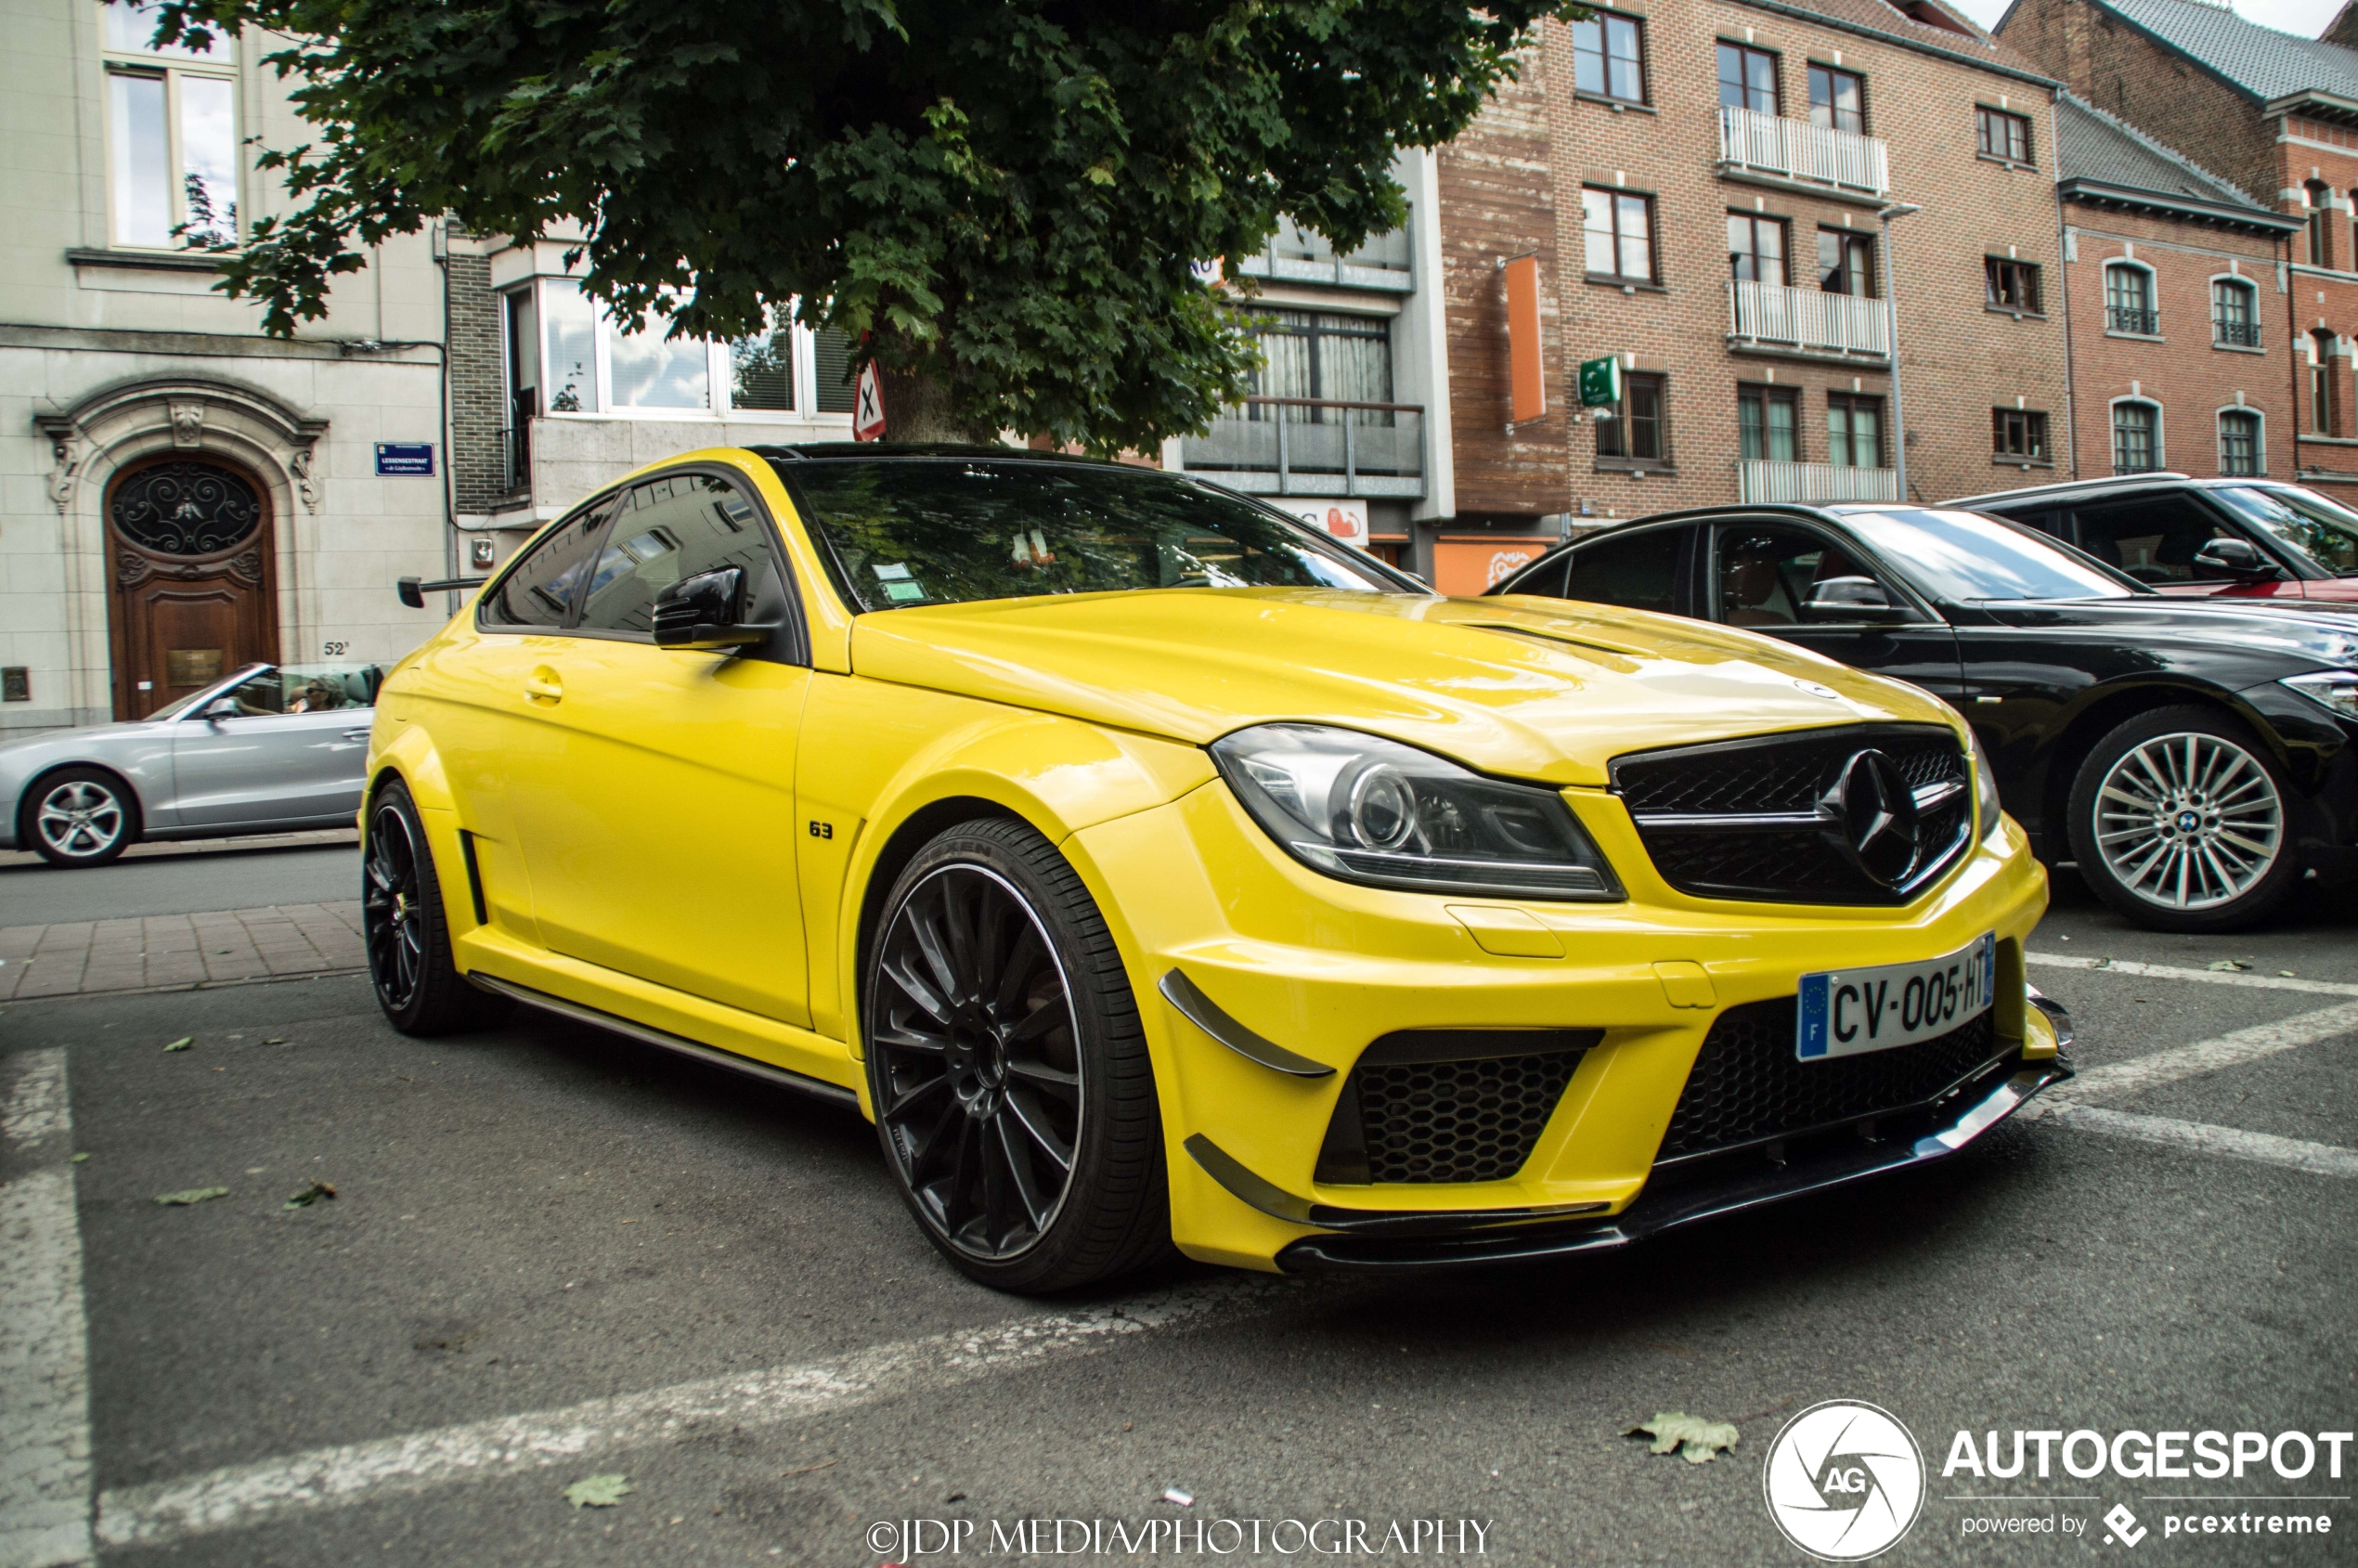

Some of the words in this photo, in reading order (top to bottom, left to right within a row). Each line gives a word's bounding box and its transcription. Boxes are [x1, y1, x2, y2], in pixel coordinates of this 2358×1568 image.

[810, 820, 833, 840] 63
[1833, 949, 1984, 1043] CV-005-HT
[1810, 1023, 1819, 1041] F
